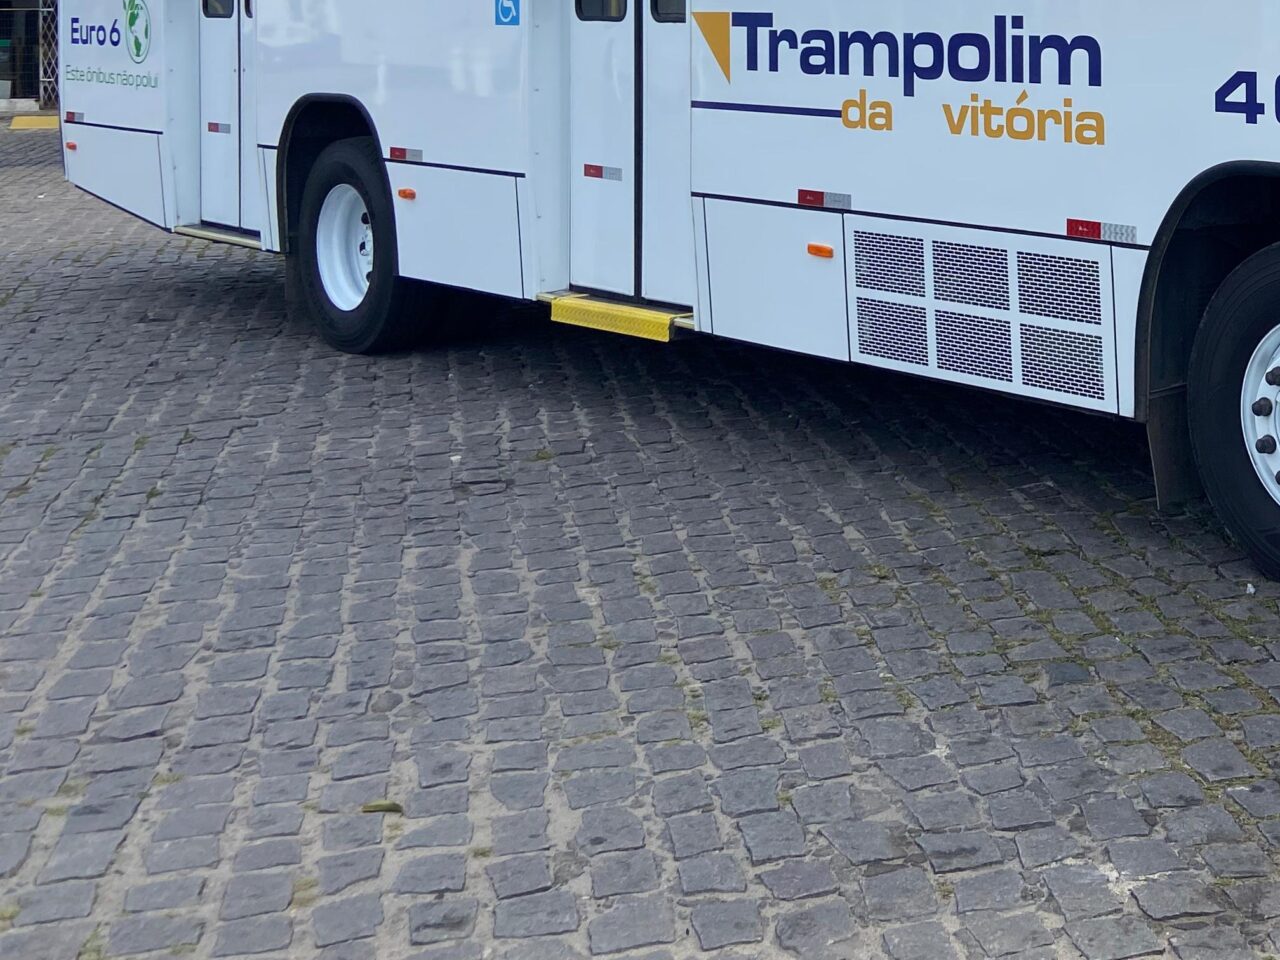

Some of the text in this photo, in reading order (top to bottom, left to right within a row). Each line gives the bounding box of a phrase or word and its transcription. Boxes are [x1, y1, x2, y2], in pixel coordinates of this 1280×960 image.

[71, 17, 121, 47] Euro 6
[731, 11, 1102, 97] Trampolim
[65, 64, 85, 81] Este
[86, 66, 115, 85] ônibus
[116, 69, 134, 86] não
[841, 88, 1106, 146] da vitória
